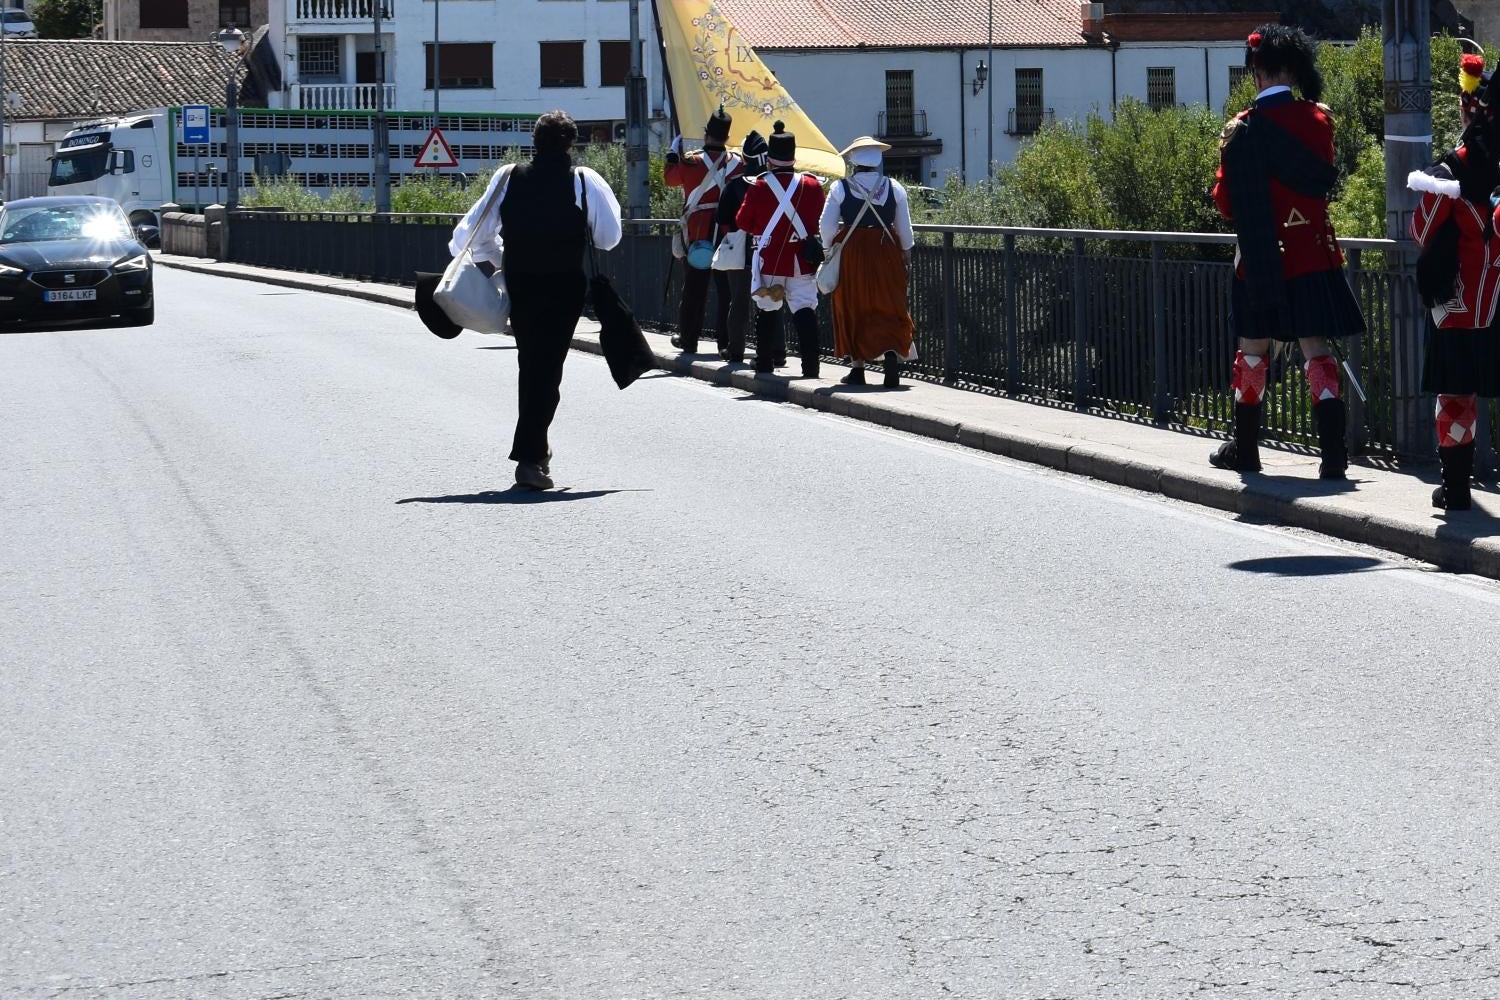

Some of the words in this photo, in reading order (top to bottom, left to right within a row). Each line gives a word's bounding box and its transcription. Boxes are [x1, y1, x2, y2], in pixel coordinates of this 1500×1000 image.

[736, 45, 754, 62] IX
[68, 135, 99, 146] DOMINGO
[76, 290, 94, 300] LKF
